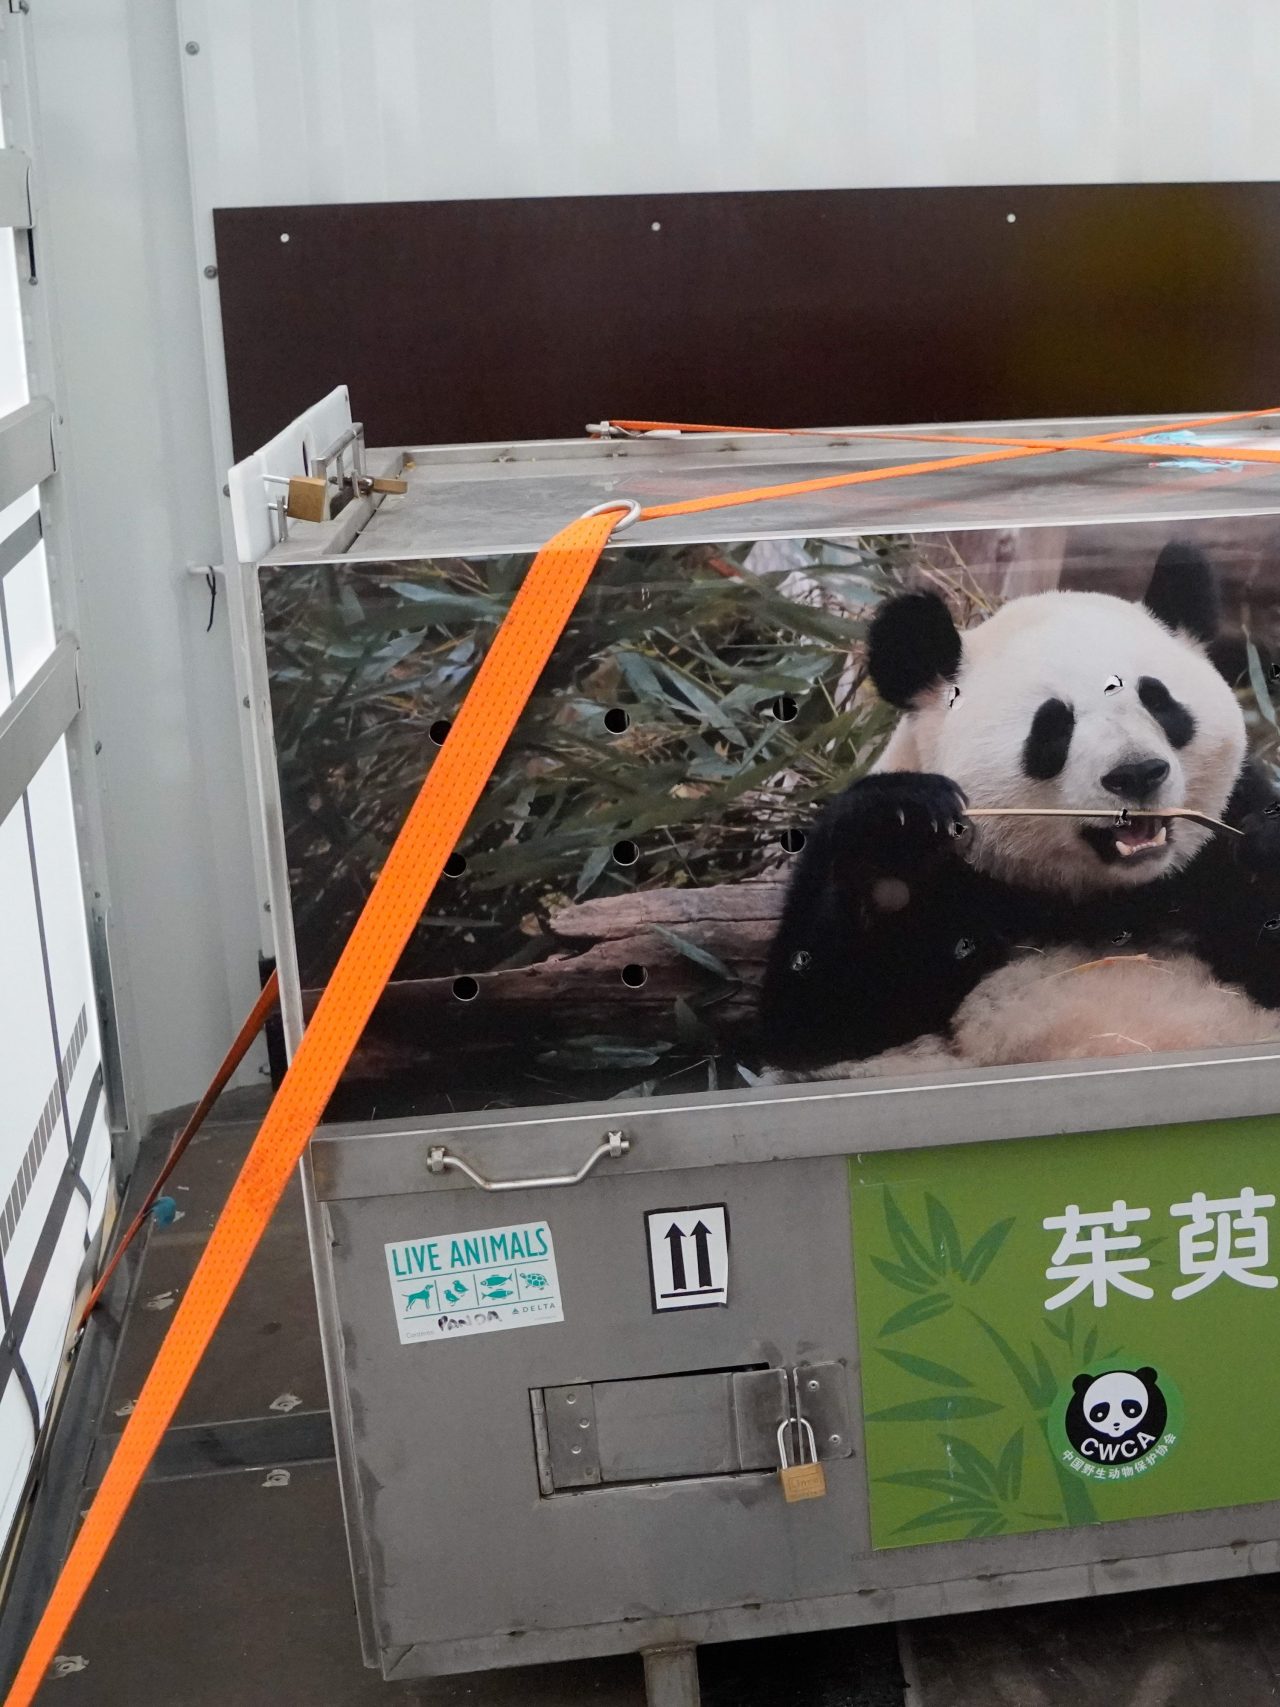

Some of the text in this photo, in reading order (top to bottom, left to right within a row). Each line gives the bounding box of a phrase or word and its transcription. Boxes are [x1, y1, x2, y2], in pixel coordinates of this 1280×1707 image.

[392, 1227, 549, 1276] LIVE ANIMALS
[1043, 1187, 1279, 1311] 茱萸
[522, 1303, 556, 1313] DELTA
[1062, 1432, 1176, 1480] 中国野生动物保护协会
[1080, 1431, 1156, 1461] CWCA
